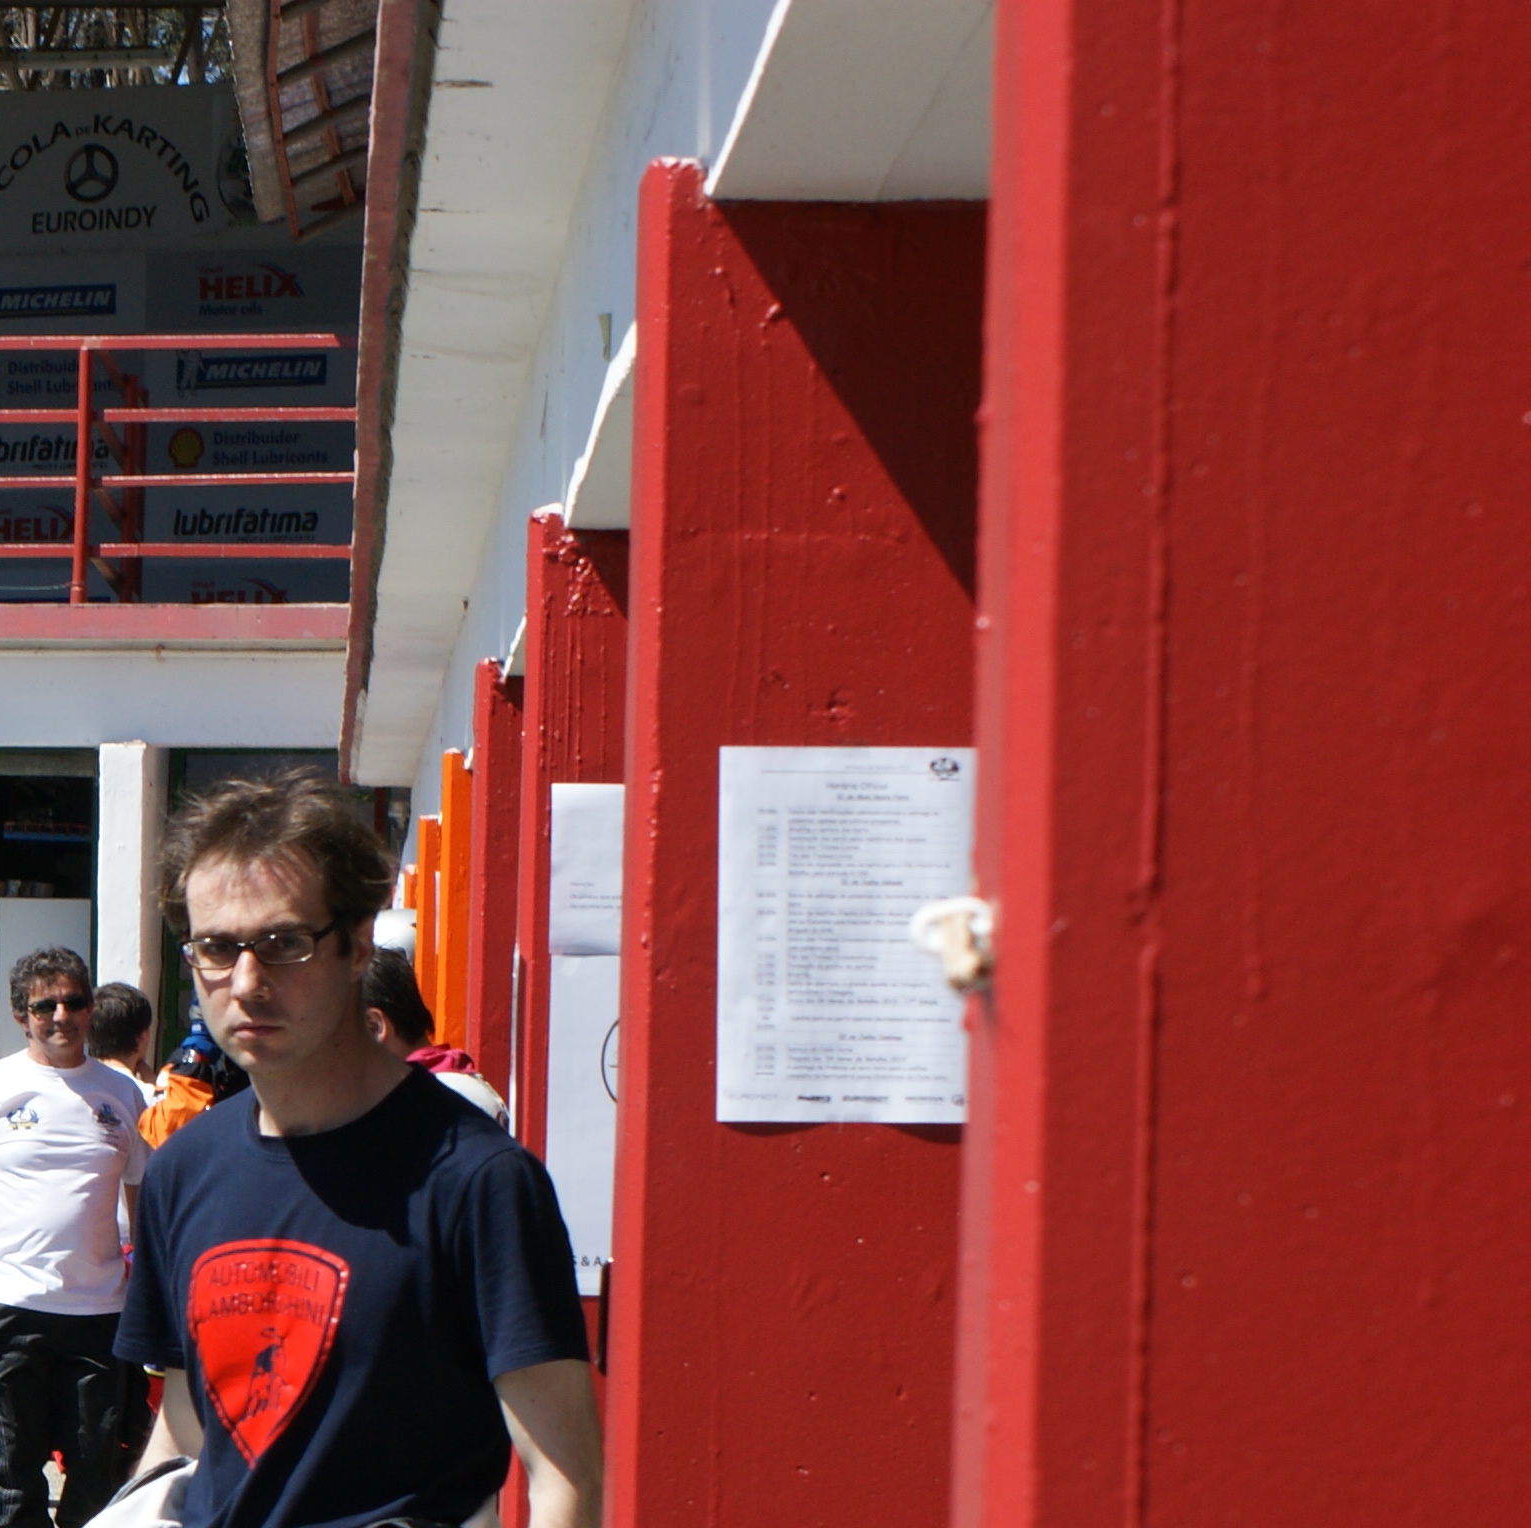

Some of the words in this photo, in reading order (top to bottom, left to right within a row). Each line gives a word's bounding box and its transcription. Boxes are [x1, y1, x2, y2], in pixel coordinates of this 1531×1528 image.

[92, 114, 211, 224] KARTING
[31, 205, 158, 235] EUROINDY
[198, 272, 301, 300] HELIX
[0, 288, 113, 311] MICHELIN
[8, 360, 80, 376] Distribuid
[205, 358, 322, 381] MICHELIN
[7, 378, 42, 395] Shell
[212, 429, 300, 447] Distribuidor
[212, 449, 248, 466] Shell
[253, 448, 329, 465] Lubricants
[173, 507, 320, 537] lubrifatima
[211, 1260, 321, 1292] AUTOMOBILI
